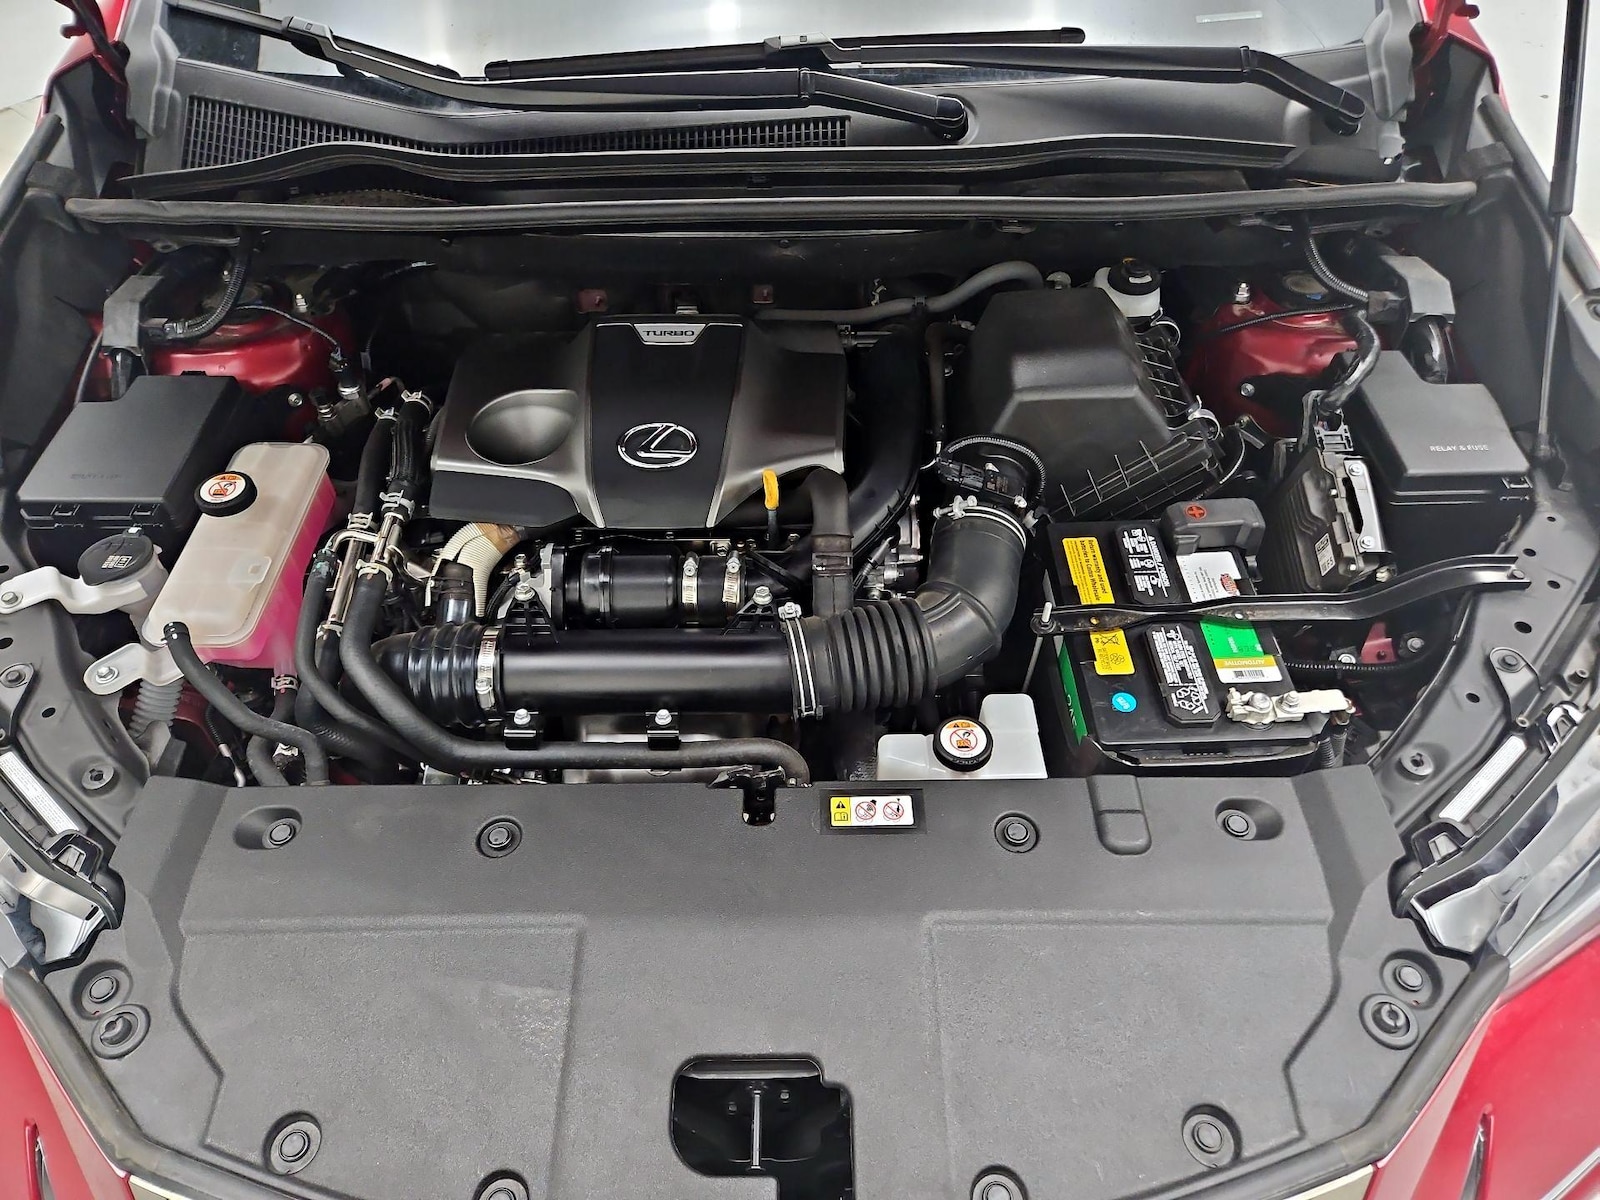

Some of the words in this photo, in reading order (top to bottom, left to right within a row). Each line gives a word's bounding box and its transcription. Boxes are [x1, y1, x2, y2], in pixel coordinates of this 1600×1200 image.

[1080, 540, 1089, 558] batteries
[1090, 577, 1101, 601] Wholesale
[1088, 540, 1096, 554] Return
[1092, 553, 1101, 573] warranty
[1100, 583, 1108, 594] used
